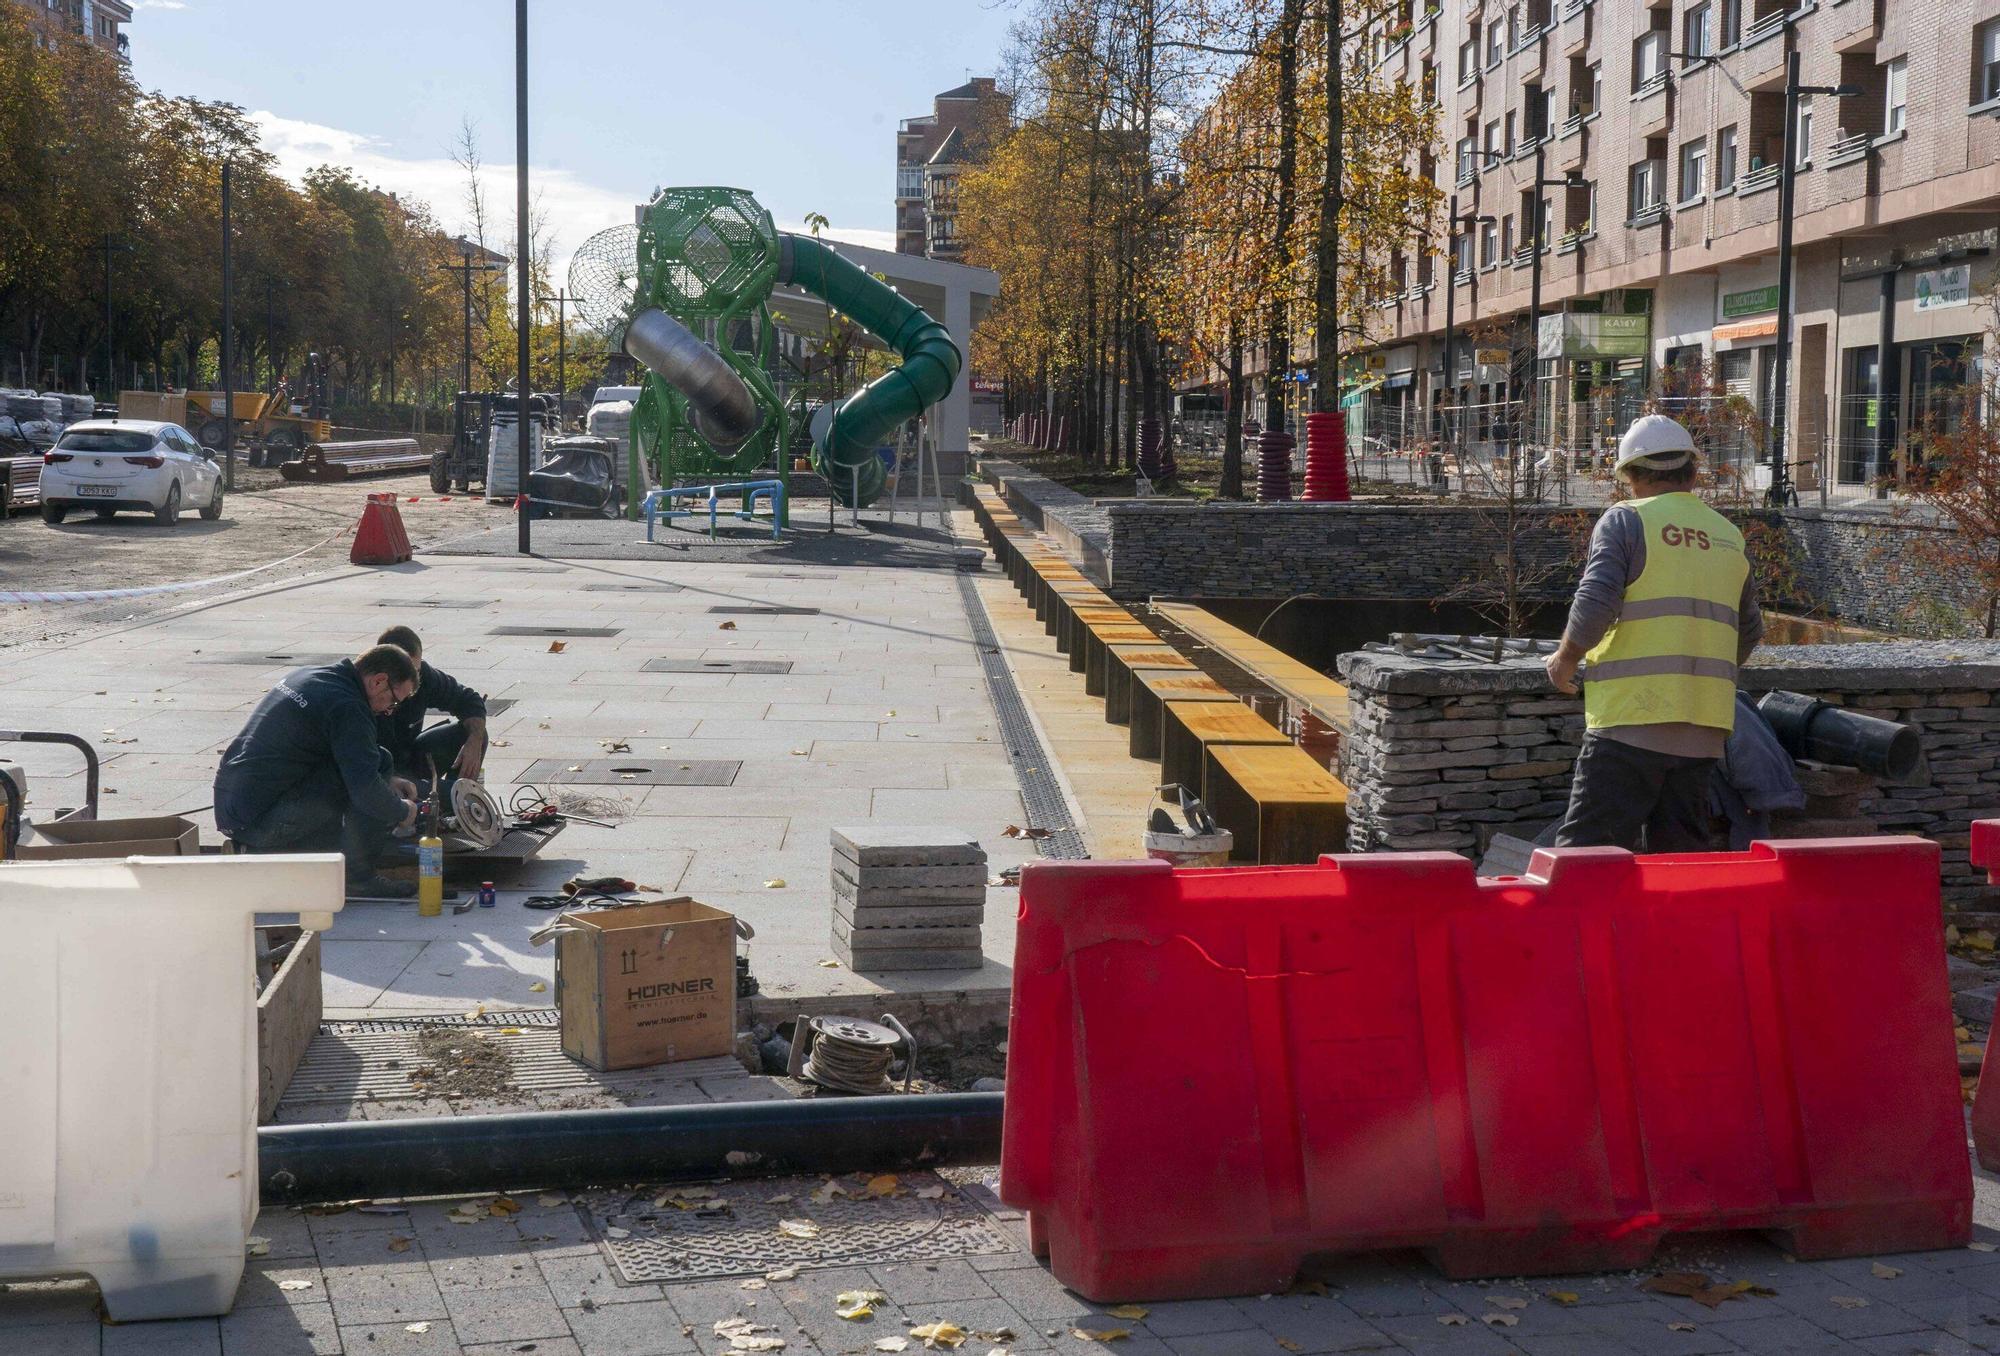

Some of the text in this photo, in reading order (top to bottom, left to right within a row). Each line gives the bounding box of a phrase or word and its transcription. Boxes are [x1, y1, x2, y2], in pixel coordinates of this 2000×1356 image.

[1661, 523, 1710, 551] GFS
[627, 978, 714, 1001] HÜRNER
[637, 1012, 708, 1027] www.huerner.de
